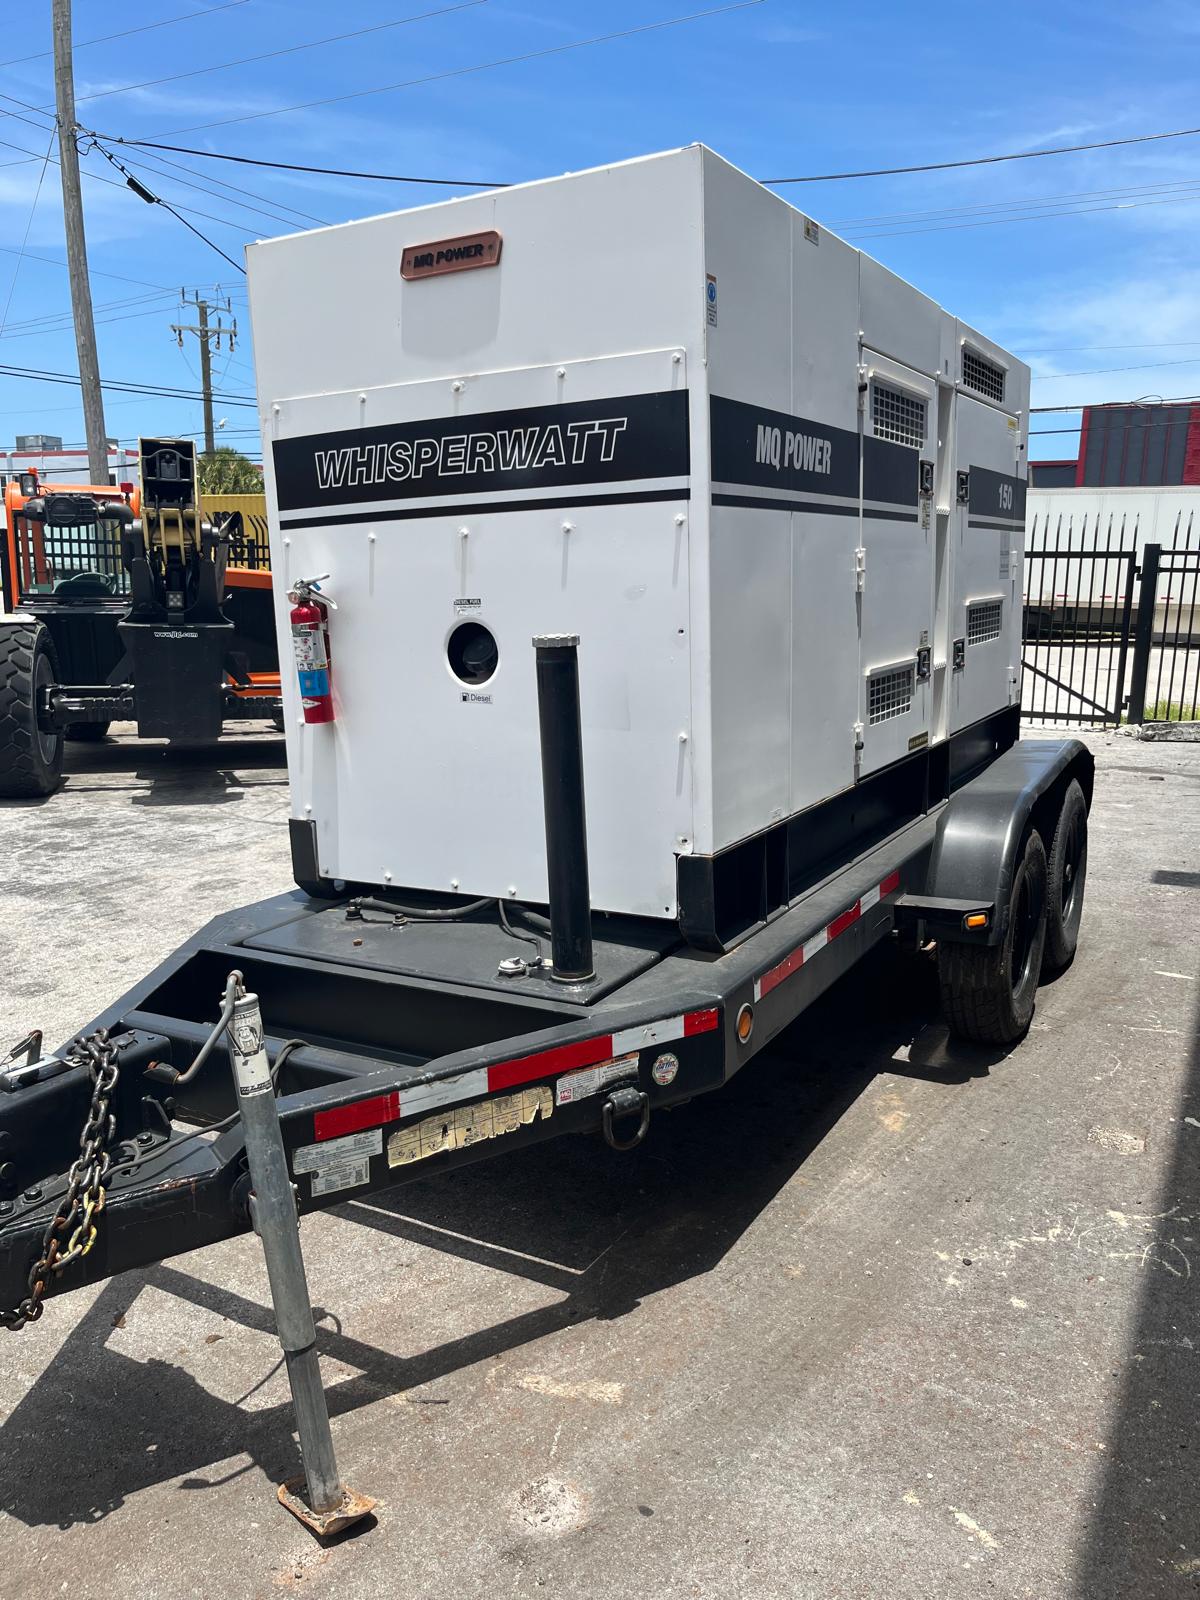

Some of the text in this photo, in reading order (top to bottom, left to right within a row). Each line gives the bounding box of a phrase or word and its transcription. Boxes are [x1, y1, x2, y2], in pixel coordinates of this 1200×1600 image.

[414, 244, 484, 268] MQ POWER
[314, 417, 628, 489] WHISPERWATT
[756, 424, 832, 474] MQ POWER
[998, 483, 1013, 510] 150
[470, 693, 491, 702] Diesel
